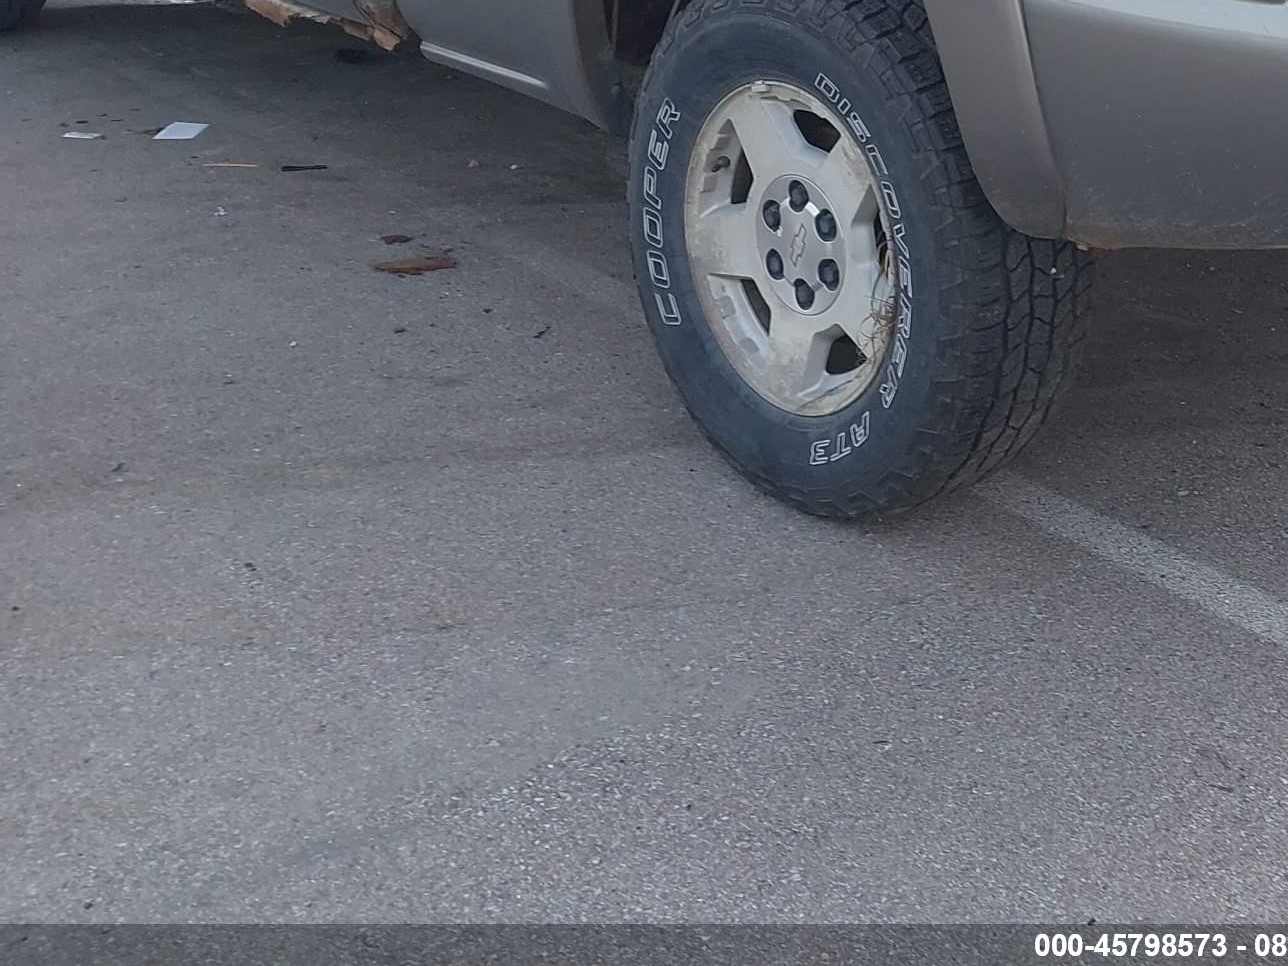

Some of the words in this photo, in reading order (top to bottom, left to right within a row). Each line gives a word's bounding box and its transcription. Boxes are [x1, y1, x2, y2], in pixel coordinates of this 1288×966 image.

[642, 98, 681, 326] COOPER
[814, 73, 914, 409] DISCOVERER
[809, 411, 870, 466] AT3
